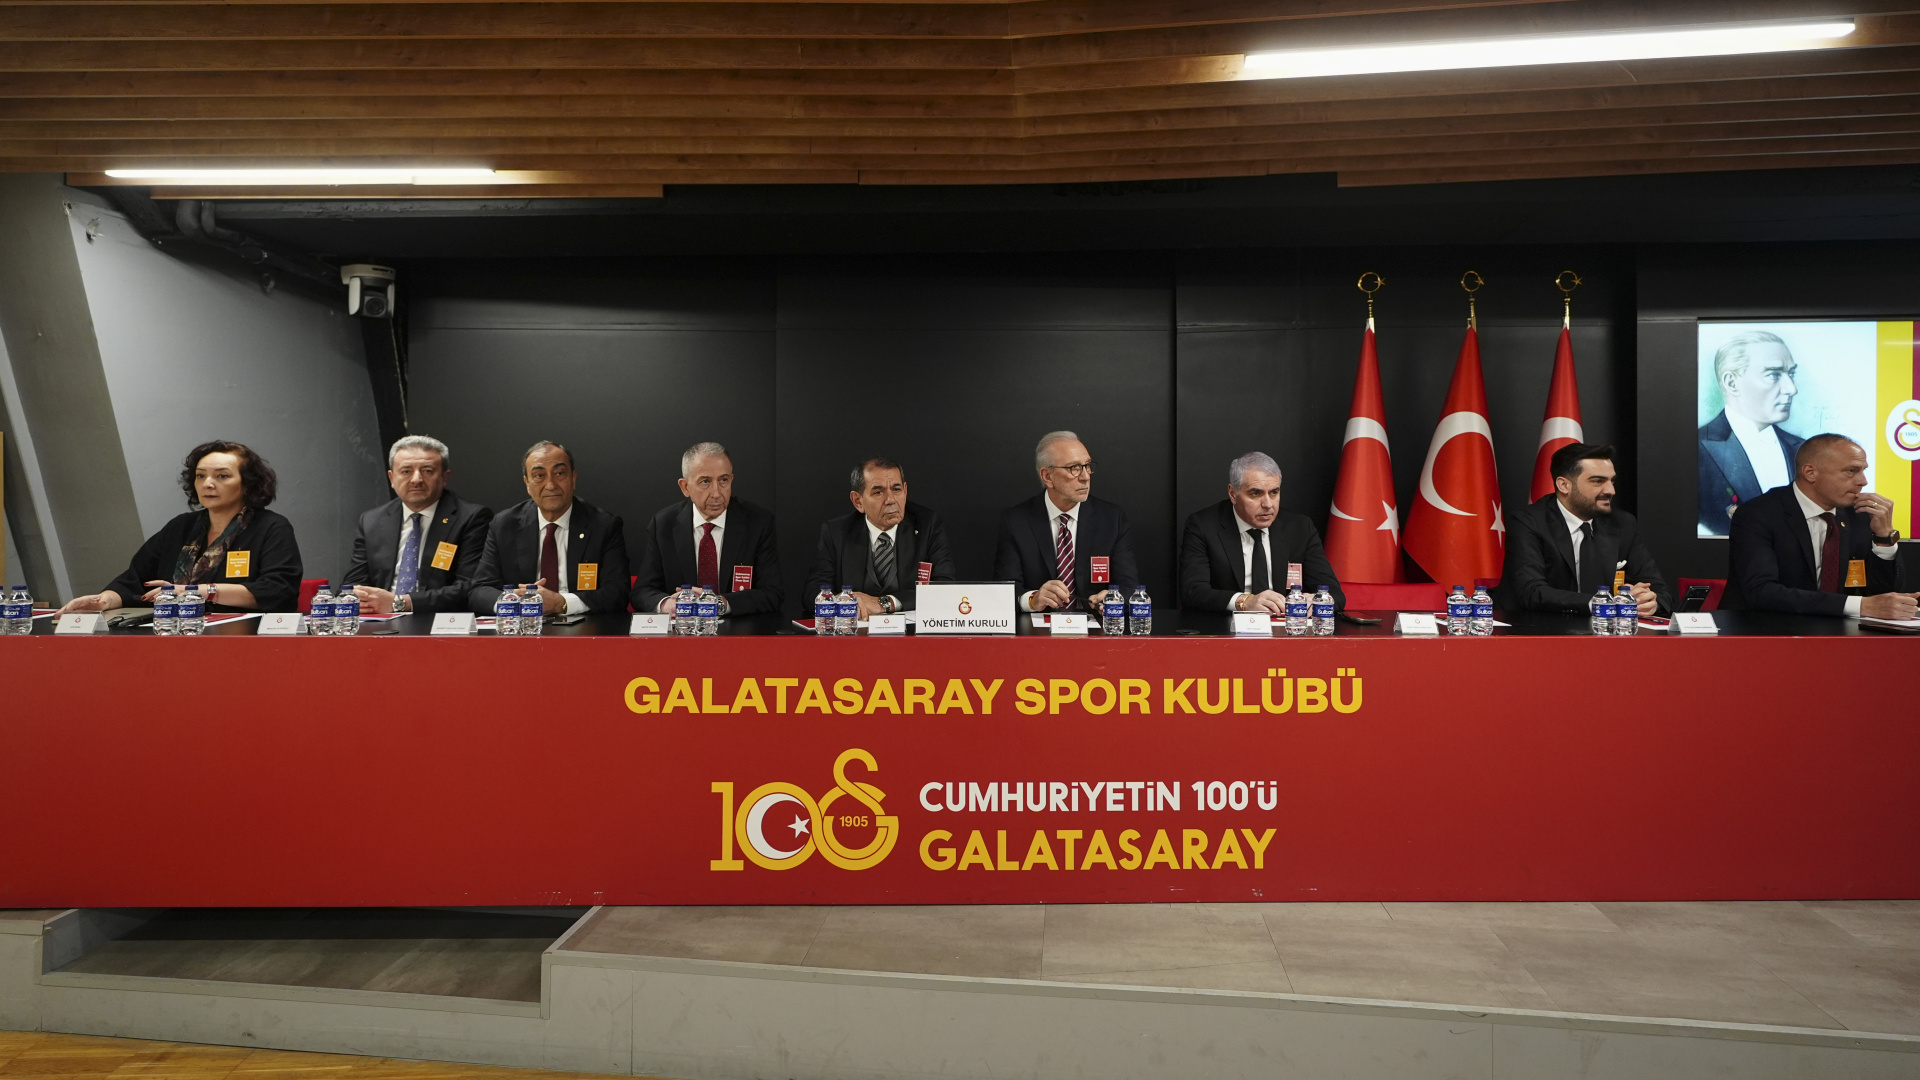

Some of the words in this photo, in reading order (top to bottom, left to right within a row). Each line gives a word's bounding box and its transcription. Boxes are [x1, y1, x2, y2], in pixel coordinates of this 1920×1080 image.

[922, 618, 966, 628] YÖNETİM
[968, 619, 1008, 628] KURULU
[624, 677, 1004, 715] GALATASARAY
[1015, 677, 1151, 715] SPOR
[1163, 668, 1363, 715] KULÜBÜ
[839, 816, 869, 828] 1905
[919, 828, 1278, 871] GALATASARAY
